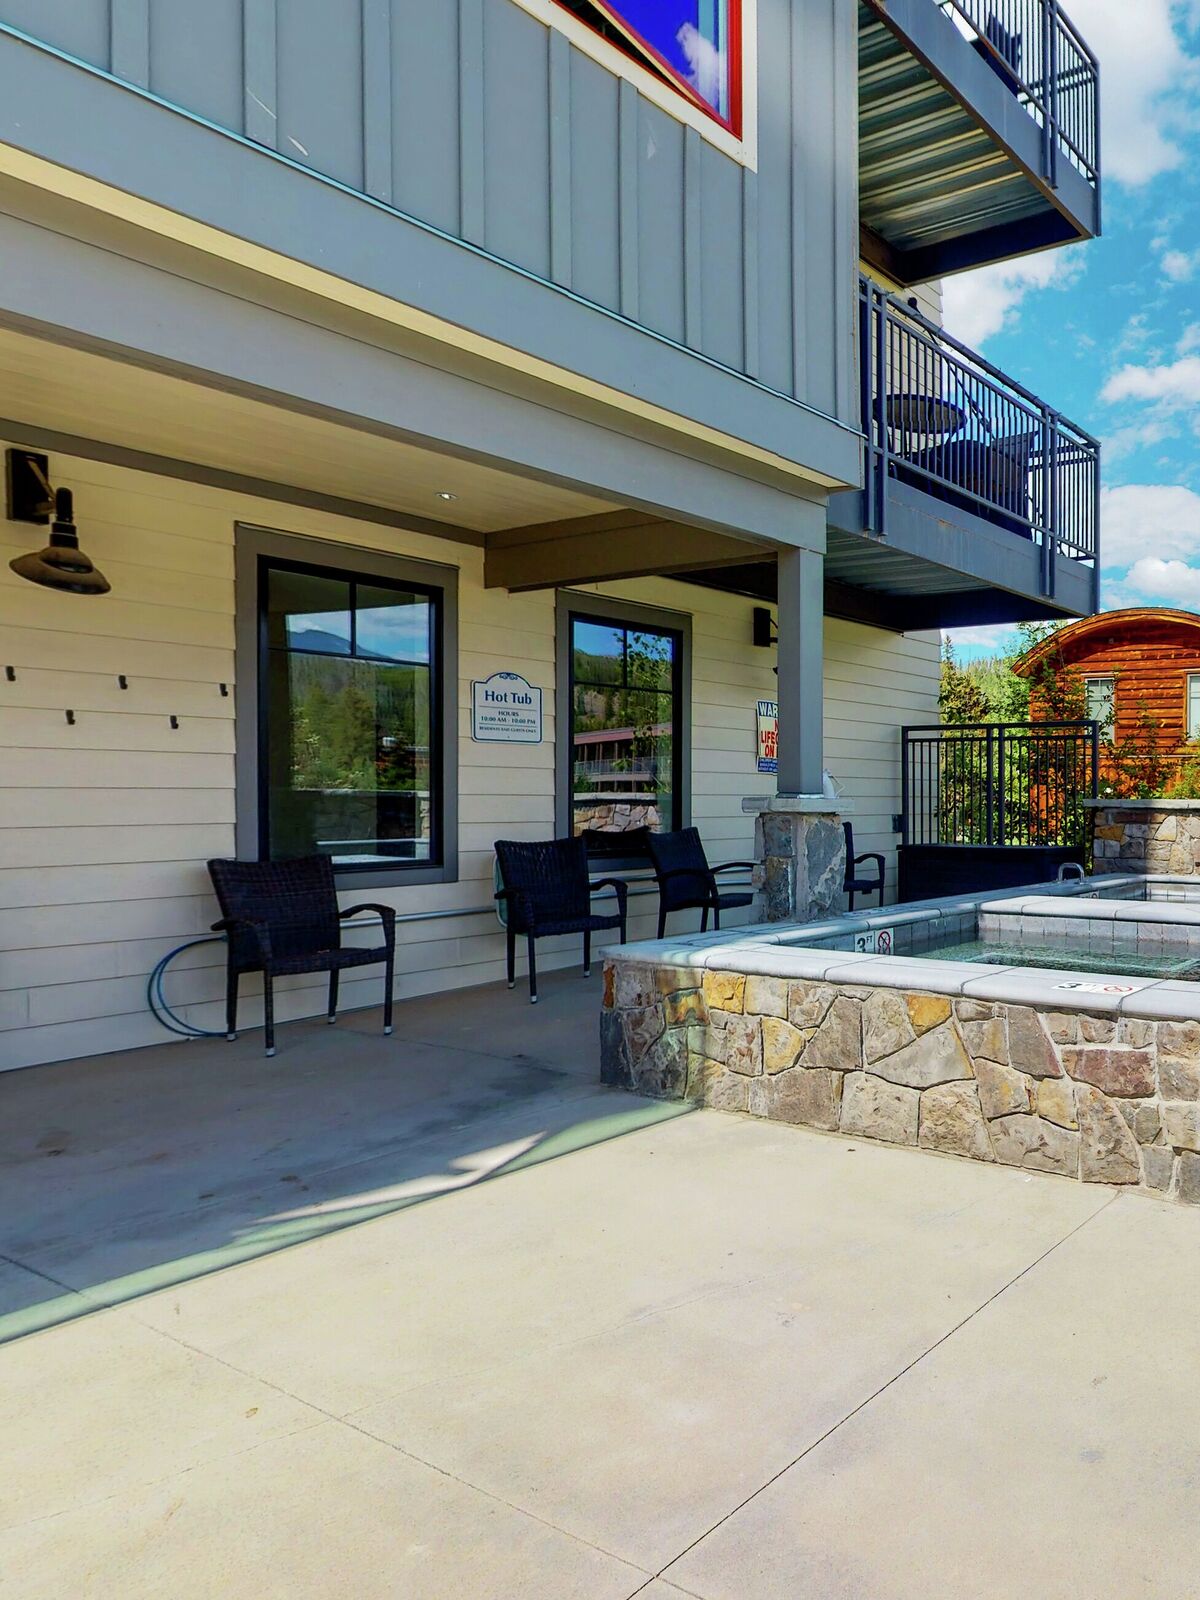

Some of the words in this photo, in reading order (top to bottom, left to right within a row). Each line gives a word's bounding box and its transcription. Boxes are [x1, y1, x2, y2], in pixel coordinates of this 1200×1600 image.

[485, 690, 508, 703] Hot
[510, 692, 532, 705] Tub
[764, 744, 775, 758] ON
